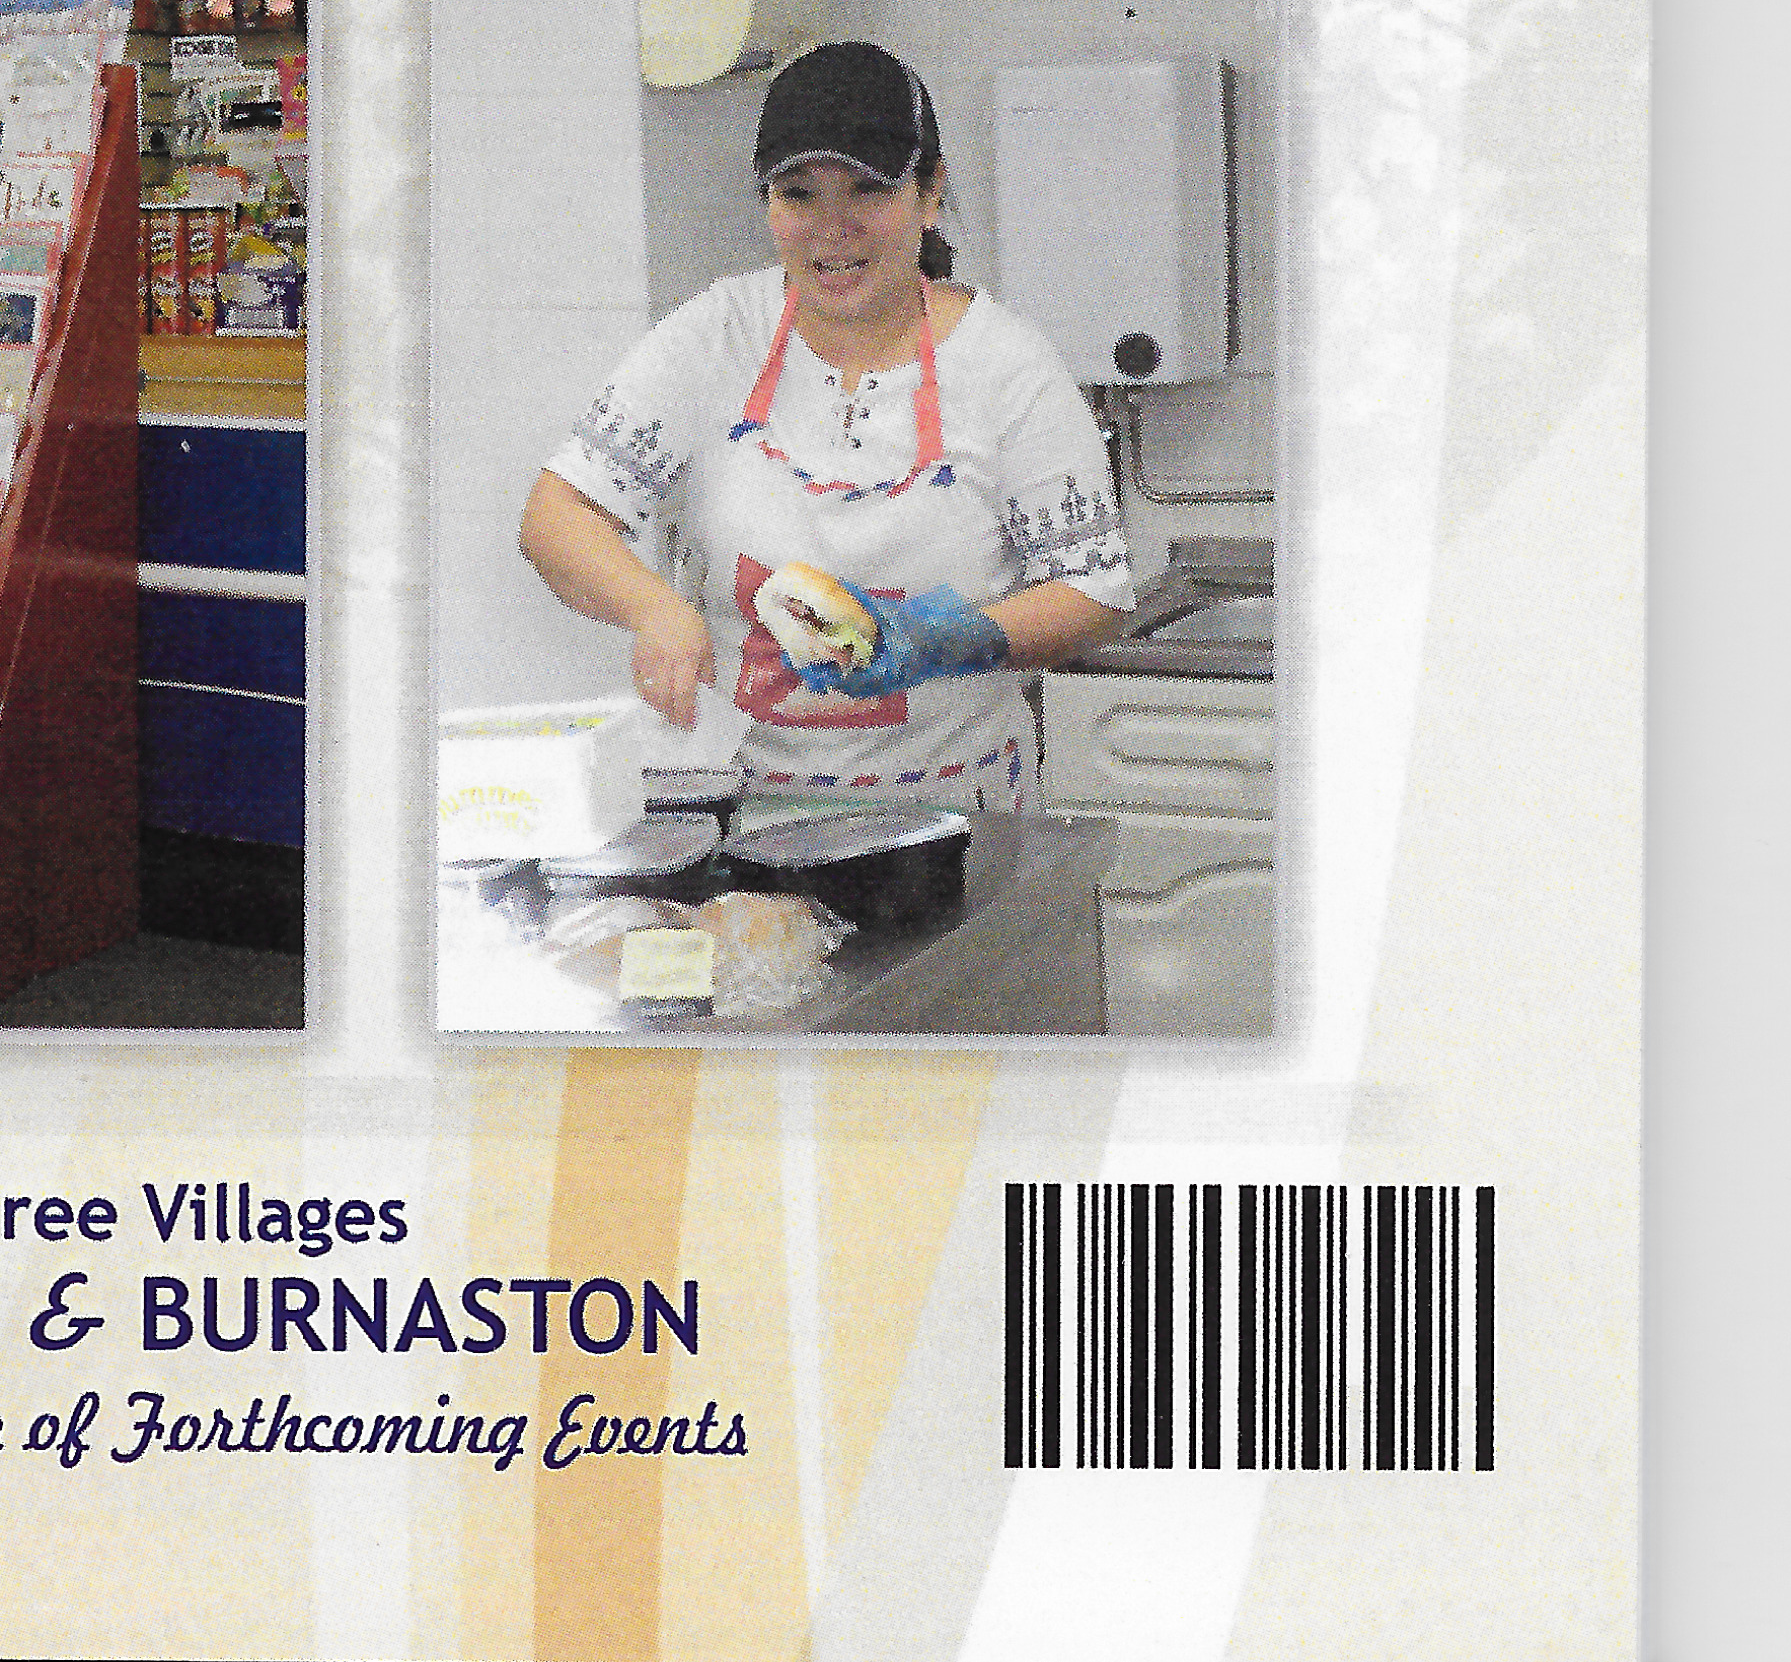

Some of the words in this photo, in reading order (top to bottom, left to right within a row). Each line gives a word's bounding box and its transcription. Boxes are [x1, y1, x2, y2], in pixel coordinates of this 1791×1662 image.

[143, 1182, 408, 1258] Villages
[30, 1272, 105, 1351] &
[143, 1276, 699, 1355] BURNASTON
[22, 1391, 100, 1471] of
[111, 1391, 528, 1471] Forthcoming
[543, 1393, 748, 1470] Events
